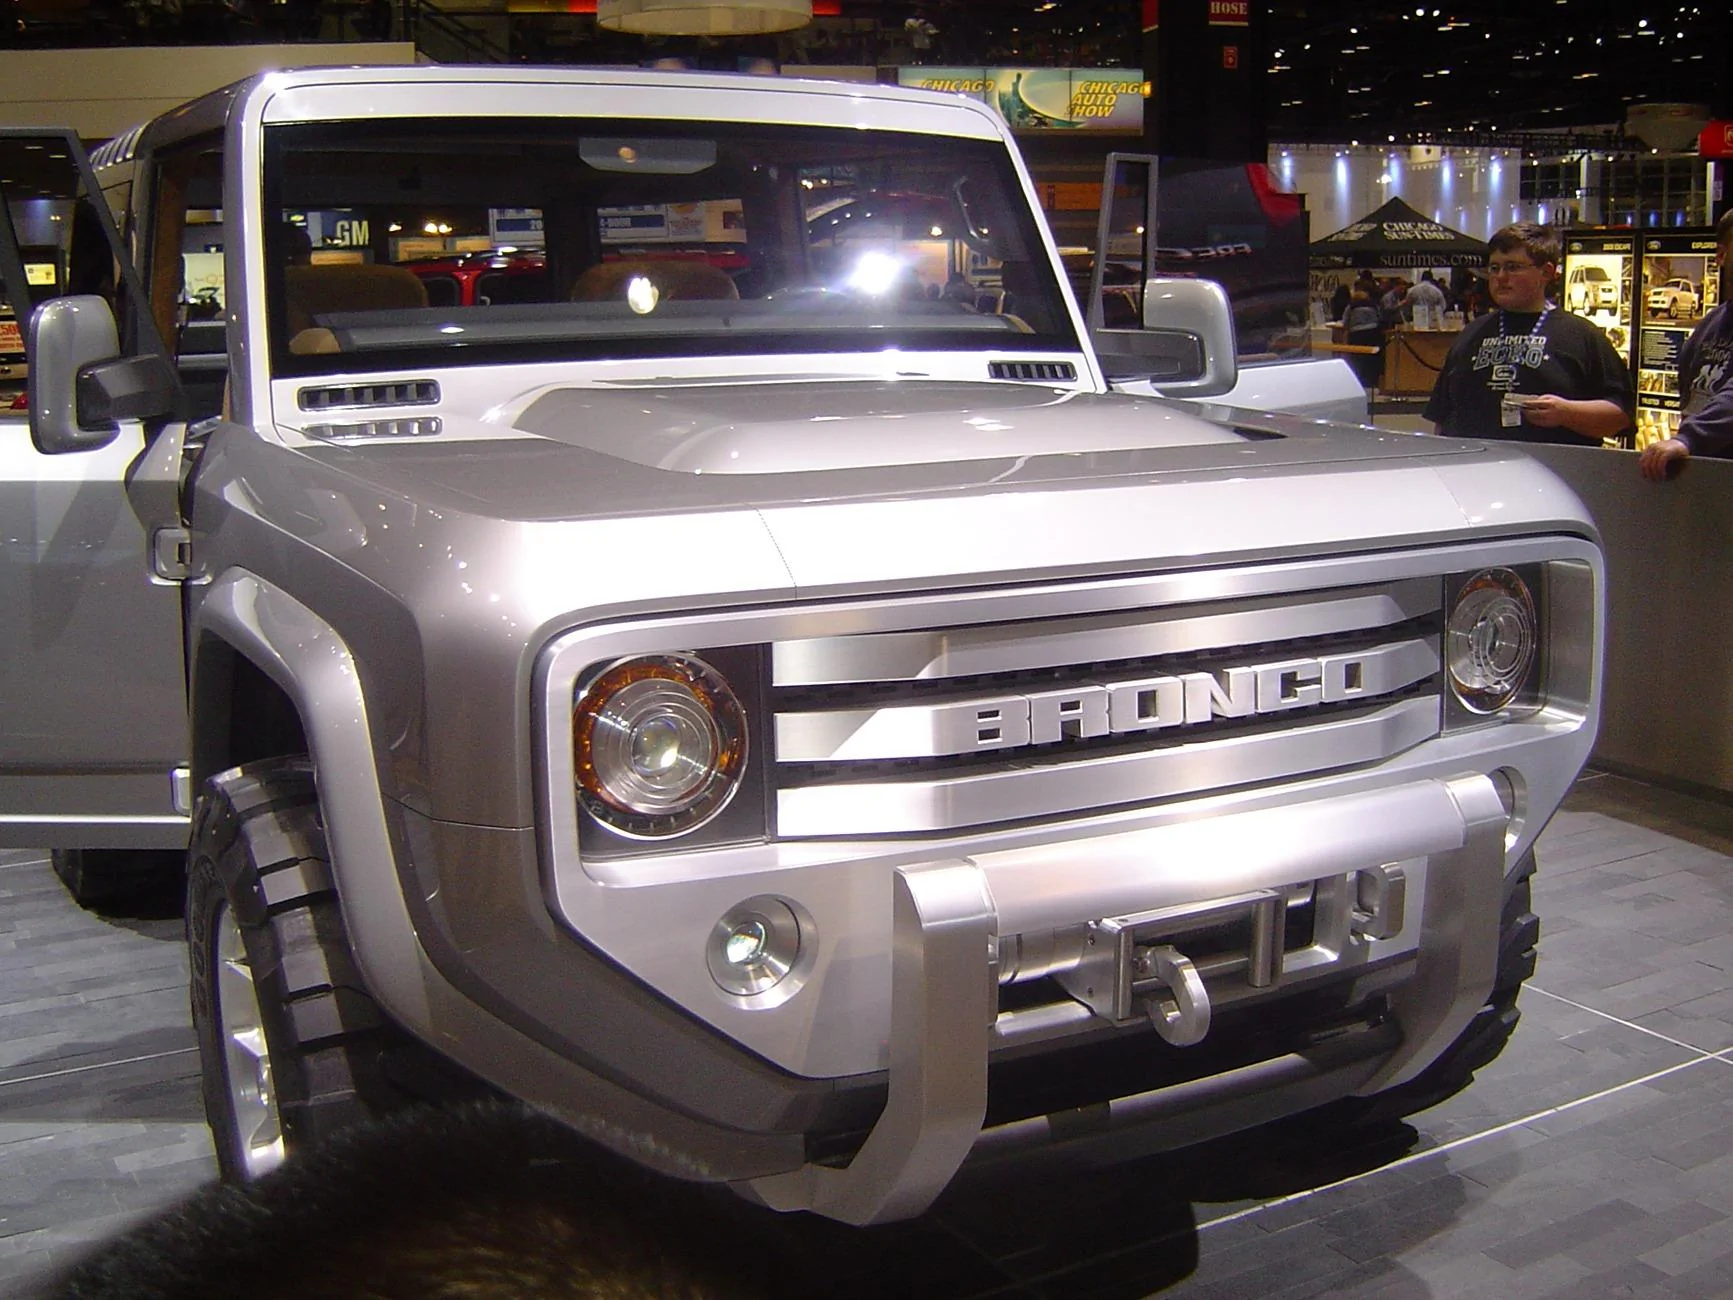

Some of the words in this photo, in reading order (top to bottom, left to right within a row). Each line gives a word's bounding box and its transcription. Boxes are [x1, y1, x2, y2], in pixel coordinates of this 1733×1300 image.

[1211, 1, 1248, 15] HOSE
[1073, 94, 1117, 106] AUTO
[336, 220, 370, 247] GM
[1382, 222, 1443, 232] CHICAGO
[1383, 230, 1455, 240] SUN-TIMES
[1379, 251, 1482, 267] suntimes.com
[960, 651, 1378, 753] BRONCO
